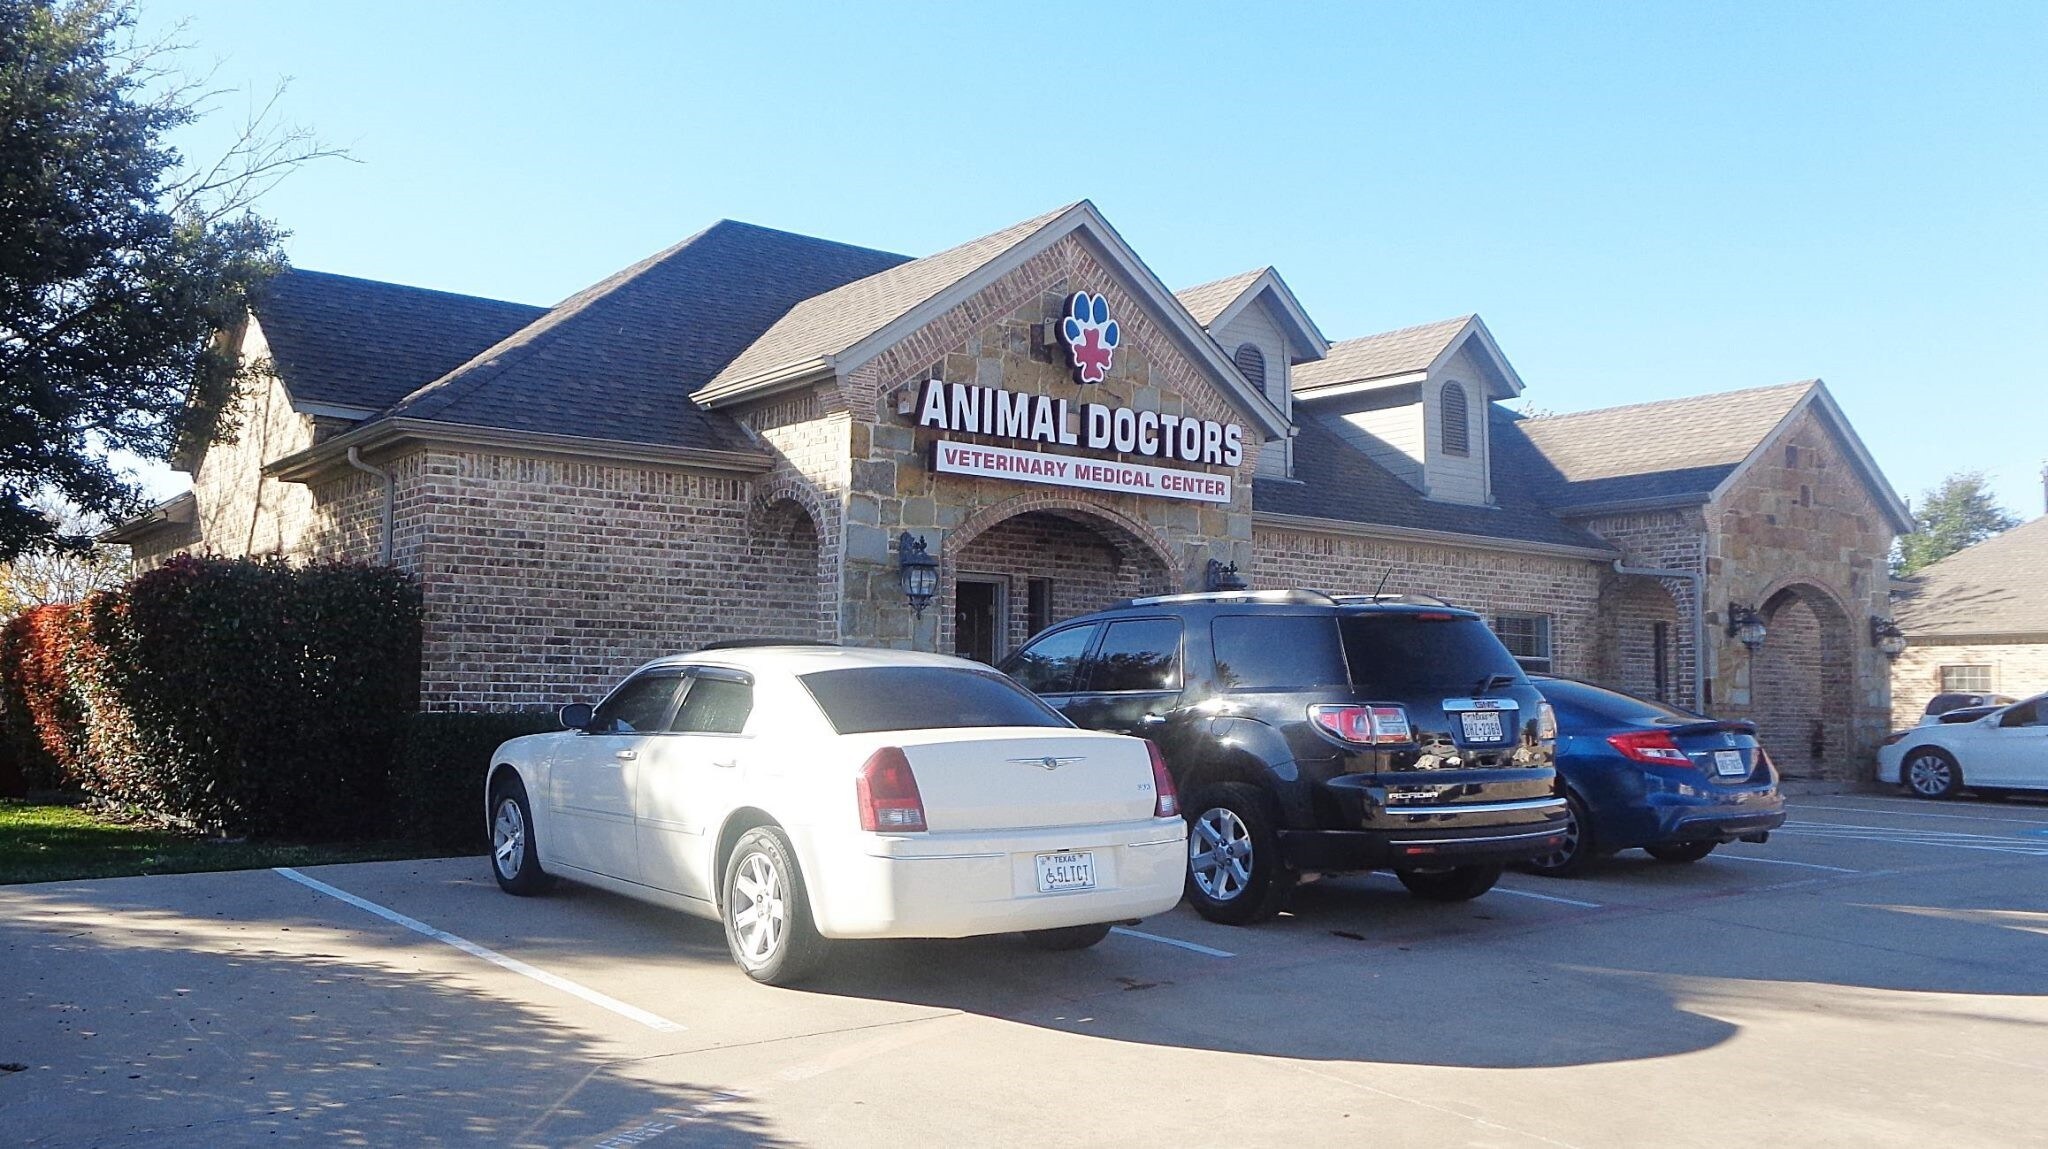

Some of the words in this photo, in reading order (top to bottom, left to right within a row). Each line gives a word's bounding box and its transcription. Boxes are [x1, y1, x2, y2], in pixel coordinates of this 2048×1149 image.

[918, 379, 1078, 446] ANIMAL
[1086, 402, 1243, 467] DOCTORS
[944, 448, 1068, 478] VETERINARY
[1074, 463, 1155, 488] MEDICAL
[1160, 474, 1226, 496] CENTER
[1053, 855, 1077, 863] TEXAS
